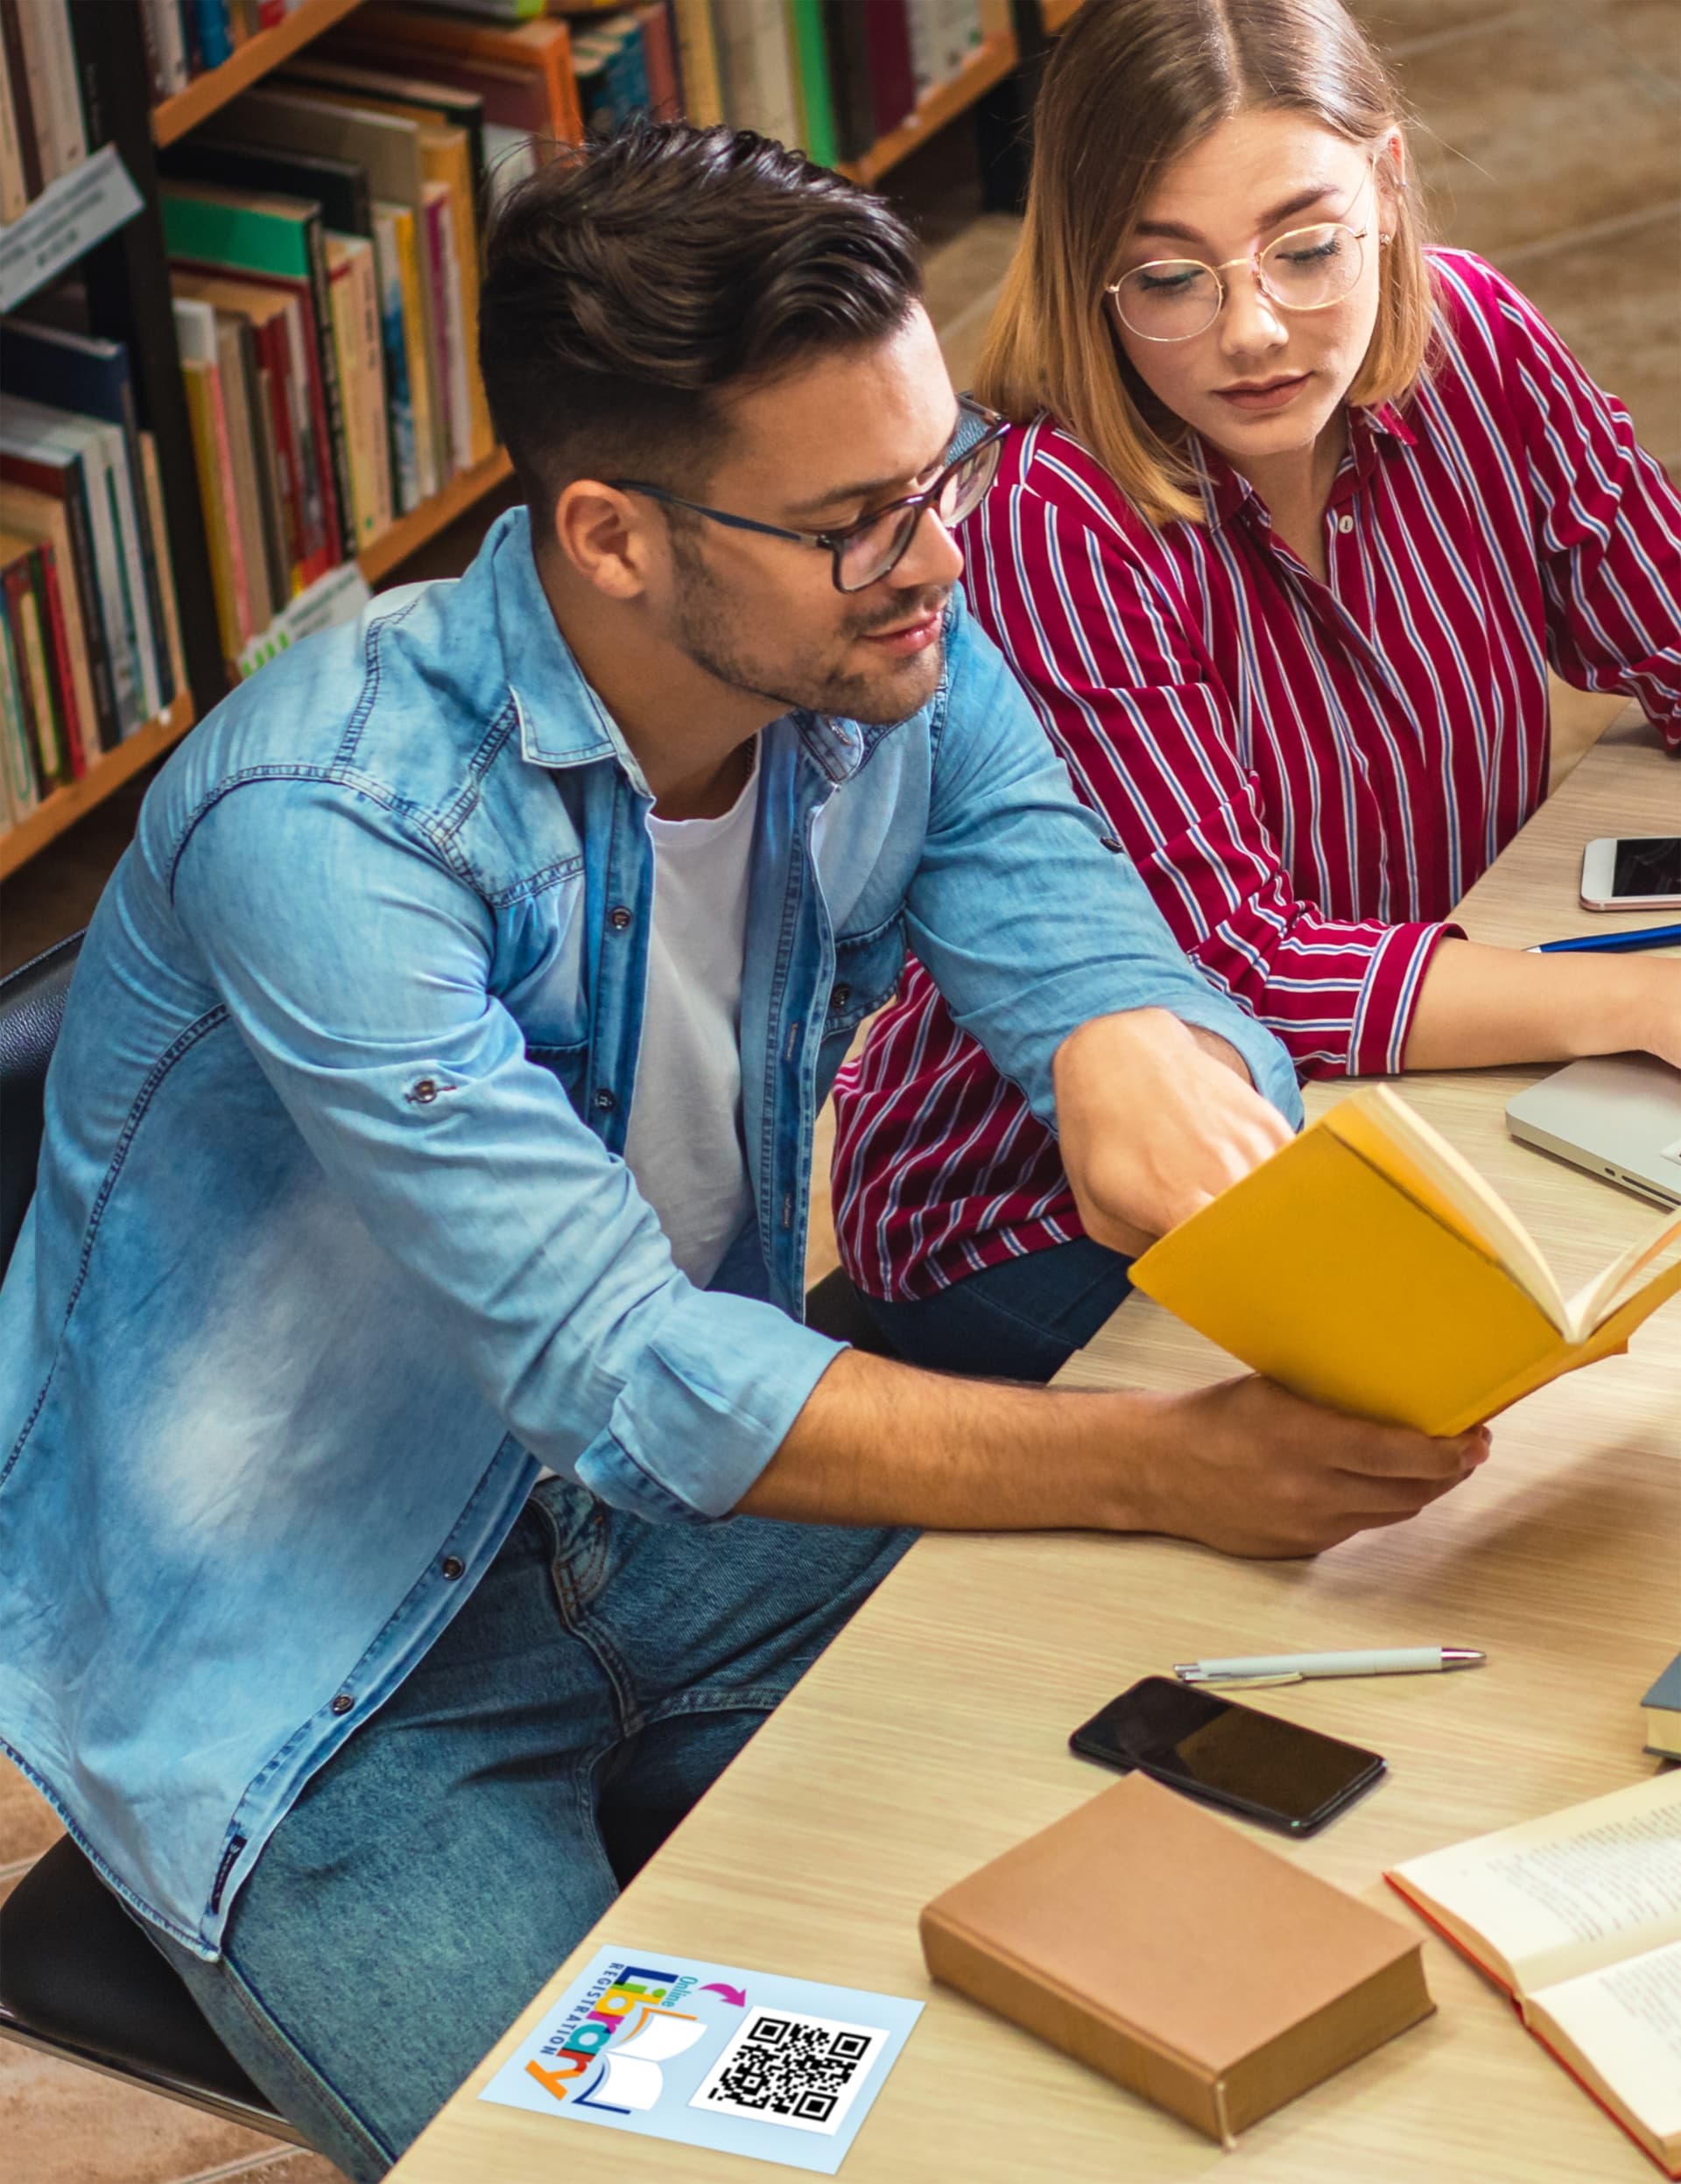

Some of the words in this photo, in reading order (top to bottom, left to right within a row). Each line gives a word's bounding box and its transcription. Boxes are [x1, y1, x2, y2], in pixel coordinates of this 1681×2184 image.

[524, 1965, 679, 2102] Library
[539, 1962, 625, 2056] REGISTRATION
[661, 1976, 699, 2007] Online
